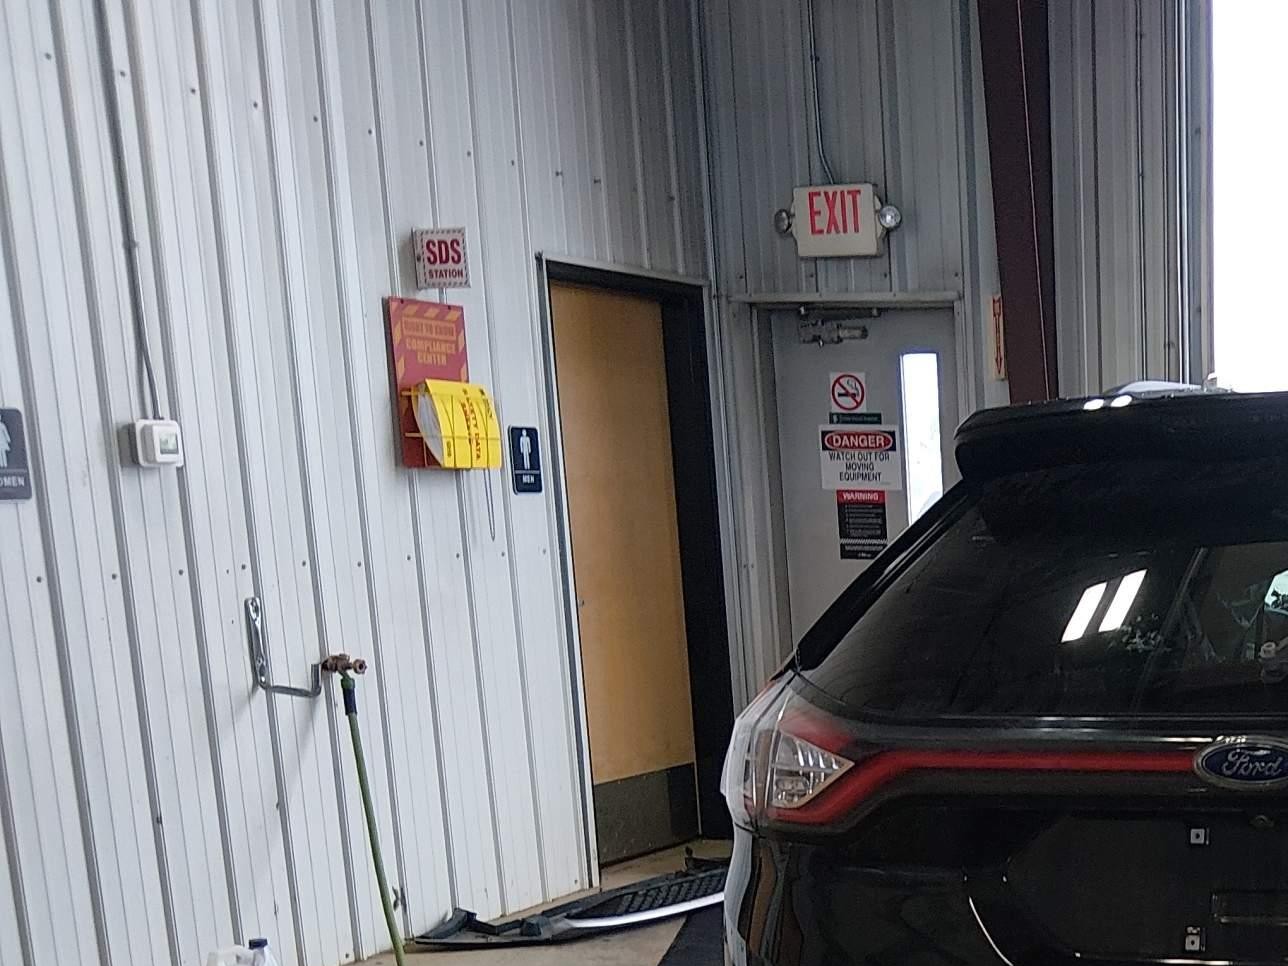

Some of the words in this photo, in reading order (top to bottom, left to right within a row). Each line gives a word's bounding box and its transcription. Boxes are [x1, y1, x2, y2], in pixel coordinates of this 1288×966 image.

[808, 189, 861, 235] EXIT
[425, 239, 462, 265] SDS
[428, 268, 464, 280] STATION
[406, 337, 457, 354] COMPLIANCE
[417, 352, 447, 366] CENTER
[832, 434, 885, 448] DANGER
[829, 451, 856, 461] WATCH
[857, 451, 873, 461] OUT
[874, 452, 890, 461] FOR
[845, 461, 875, 472] MOVING
[522, 474, 535, 484] MEN
[839, 471, 882, 482] EQUIPMENT
[842, 491, 879, 501] WARNING
[1220, 748, 1285, 777] Ford
